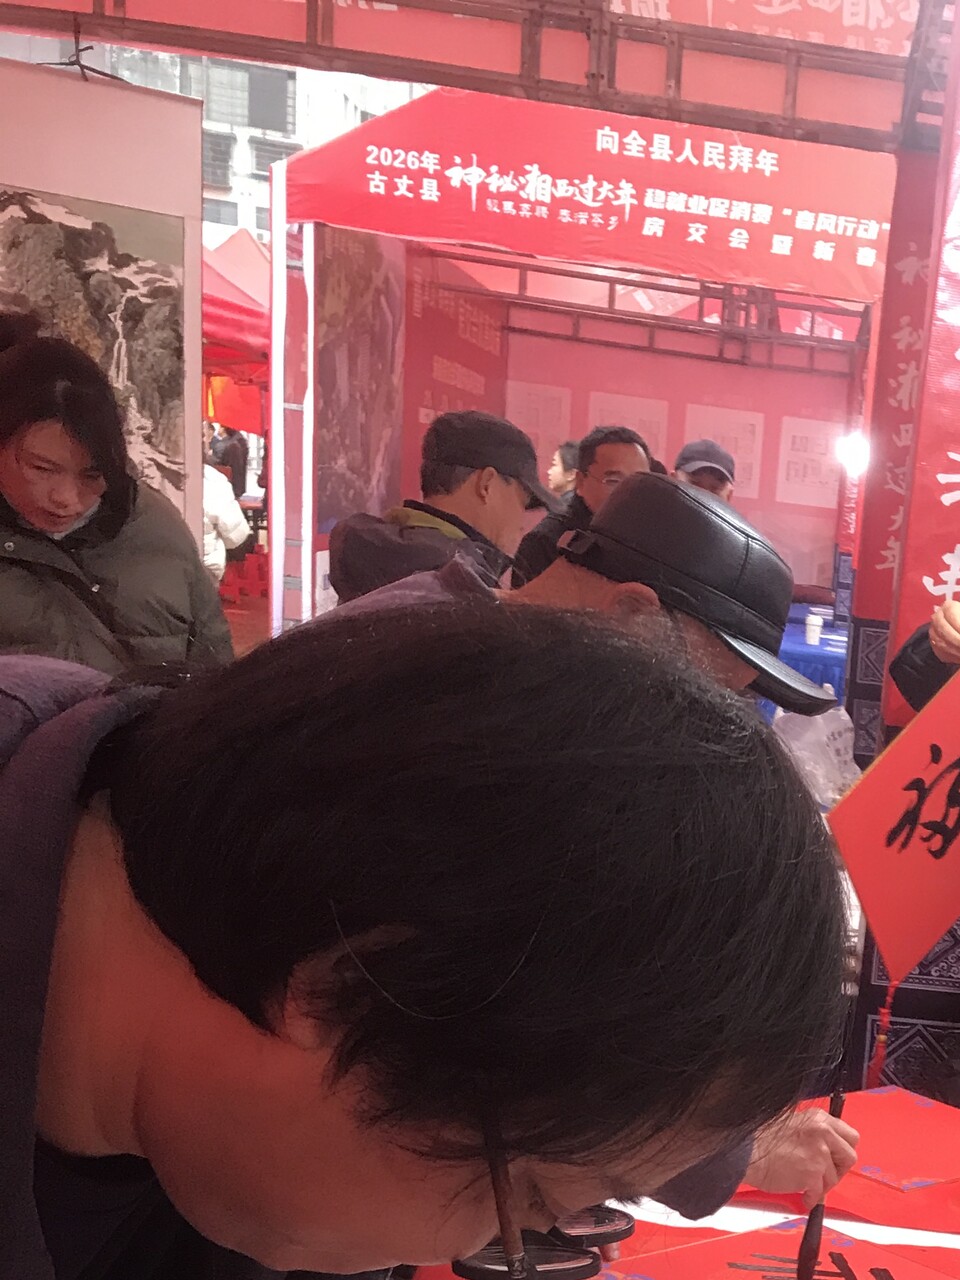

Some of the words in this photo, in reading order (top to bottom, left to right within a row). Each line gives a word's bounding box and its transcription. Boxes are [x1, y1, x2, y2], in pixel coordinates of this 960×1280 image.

[366, 145, 441, 174] 2026年
[595, 126, 779, 177] 向全县人民拜年
[366, 170, 441, 202] 古丈县
[444, 153, 638, 223] 神秘湘西过大年
